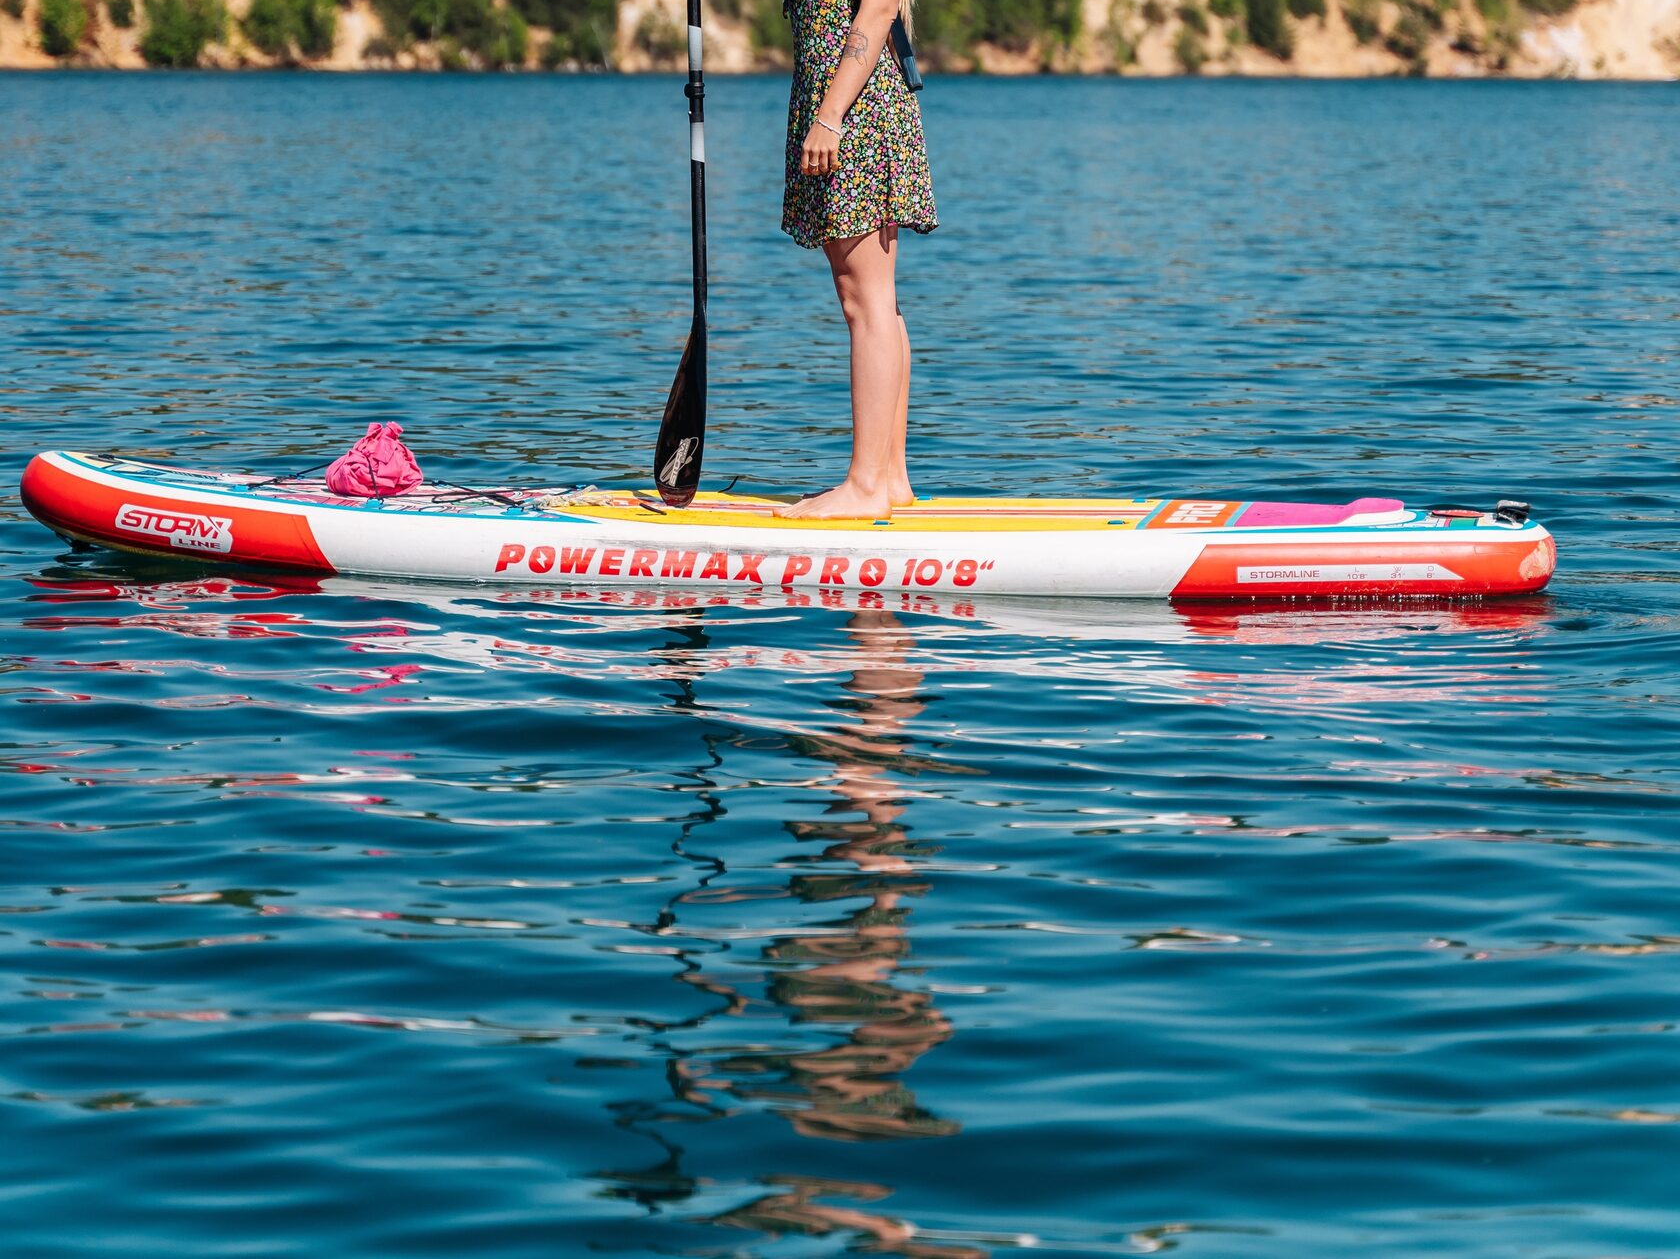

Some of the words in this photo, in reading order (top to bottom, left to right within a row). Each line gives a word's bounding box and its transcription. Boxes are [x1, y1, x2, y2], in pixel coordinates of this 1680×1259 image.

[178, 538, 221, 550] LINE
[494, 543, 769, 585] POWERMAX
[780, 554, 888, 587] PRO
[1250, 570, 1320, 579] STORMLINE
